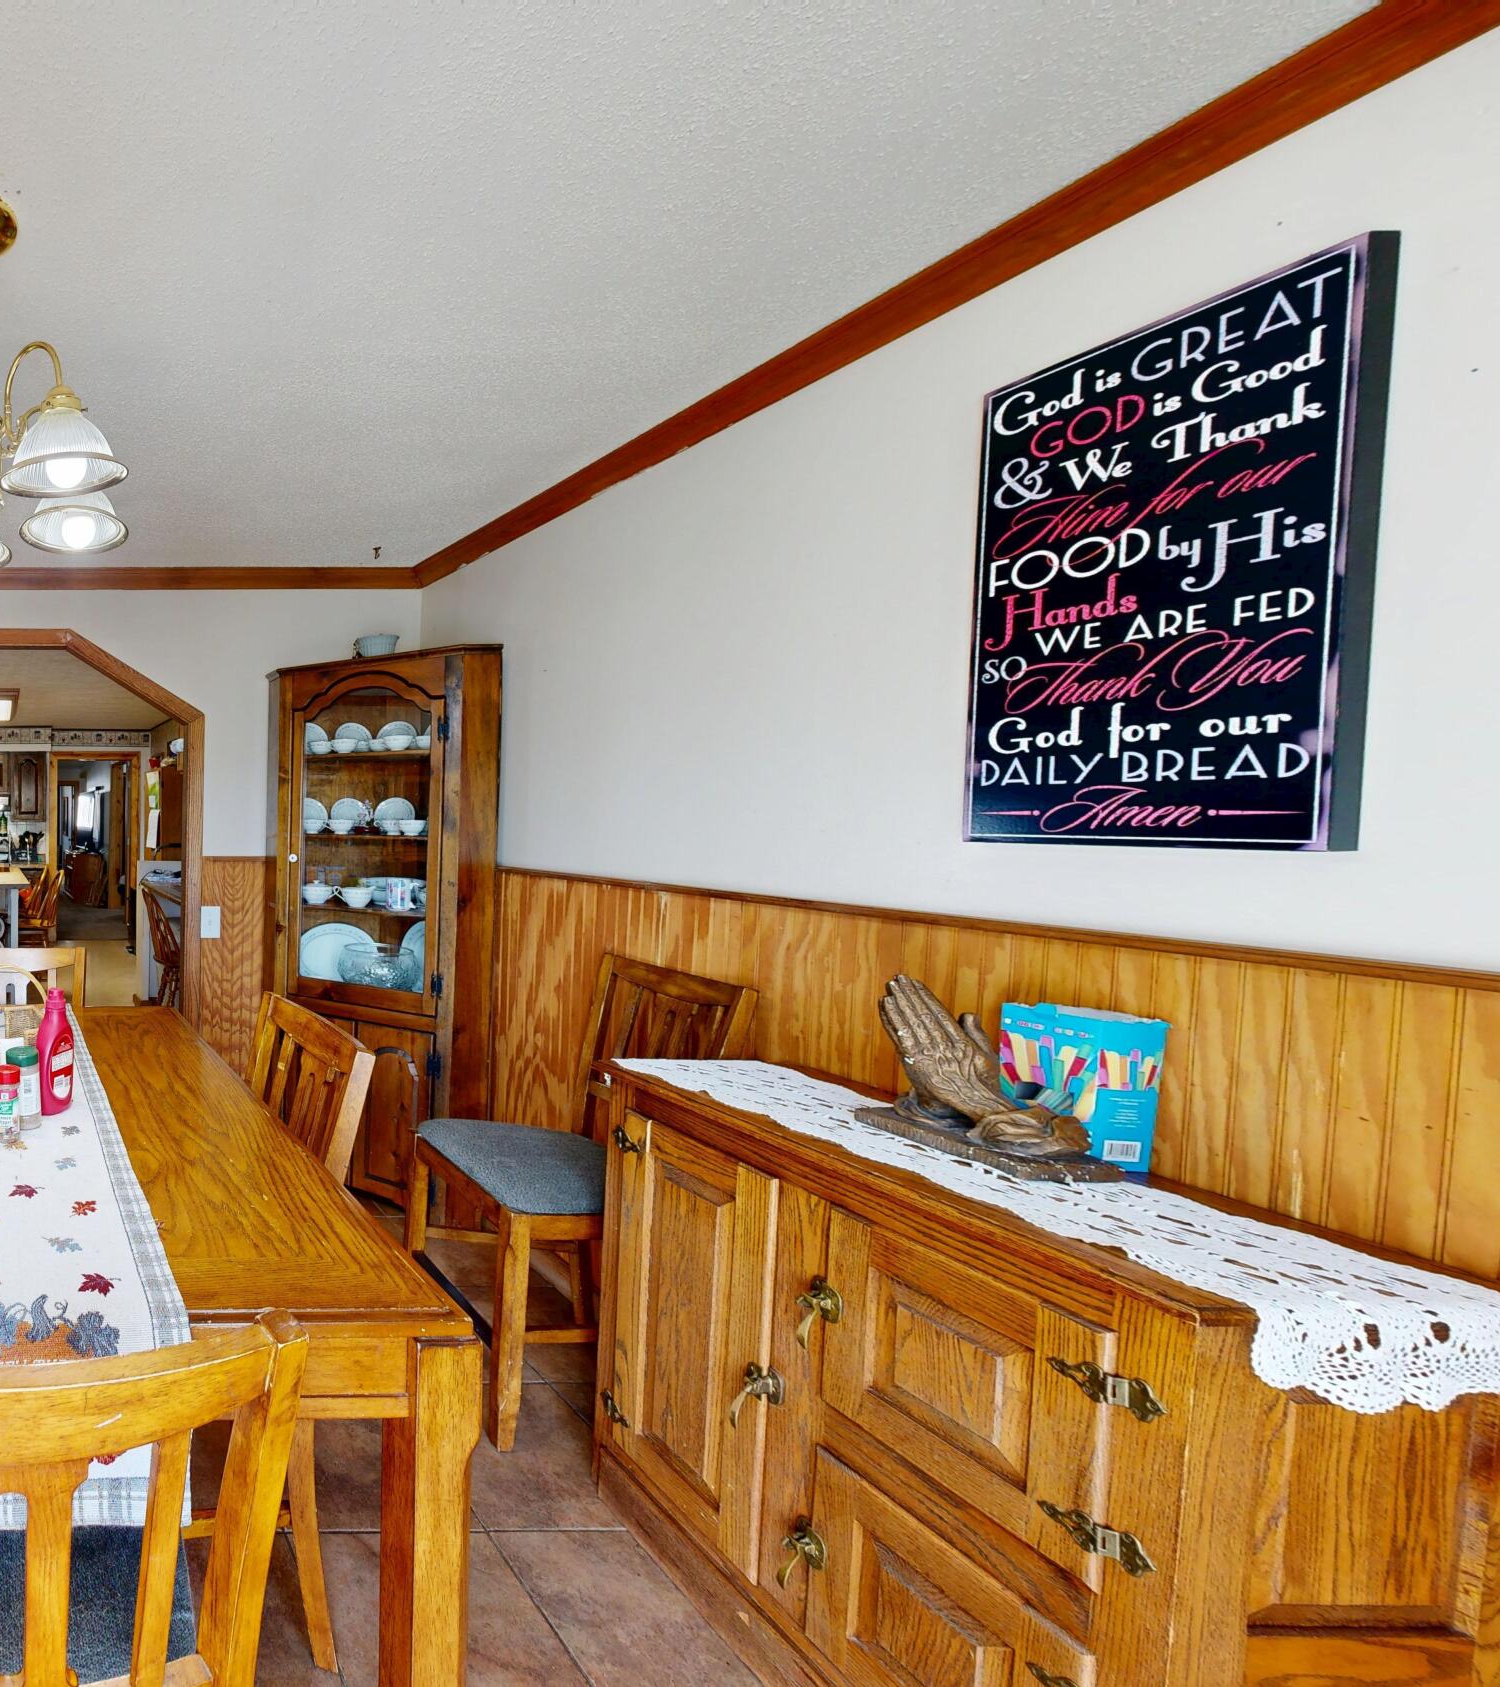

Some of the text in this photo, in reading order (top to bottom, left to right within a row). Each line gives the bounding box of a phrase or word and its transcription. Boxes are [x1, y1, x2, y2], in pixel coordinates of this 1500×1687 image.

[994, 267, 1343, 436] God is GREAT
[1031, 324, 1327, 458] GOD is Good
[993, 382, 1326, 509] & We Thank
[992, 483, 1128, 560] Him
[1216, 452, 1318, 499] our
[988, 507, 1327, 598] FOOD by His
[984, 573, 1138, 652] Hands
[1034, 587, 1316, 656] WE ARE FED
[1004, 630, 1229, 715] Thank
[1156, 628, 1315, 712] You
[980, 742, 1311, 787] DAILY BREAD
[988, 702, 1293, 758] God for our
[1039, 785, 1203, 833] Amen
